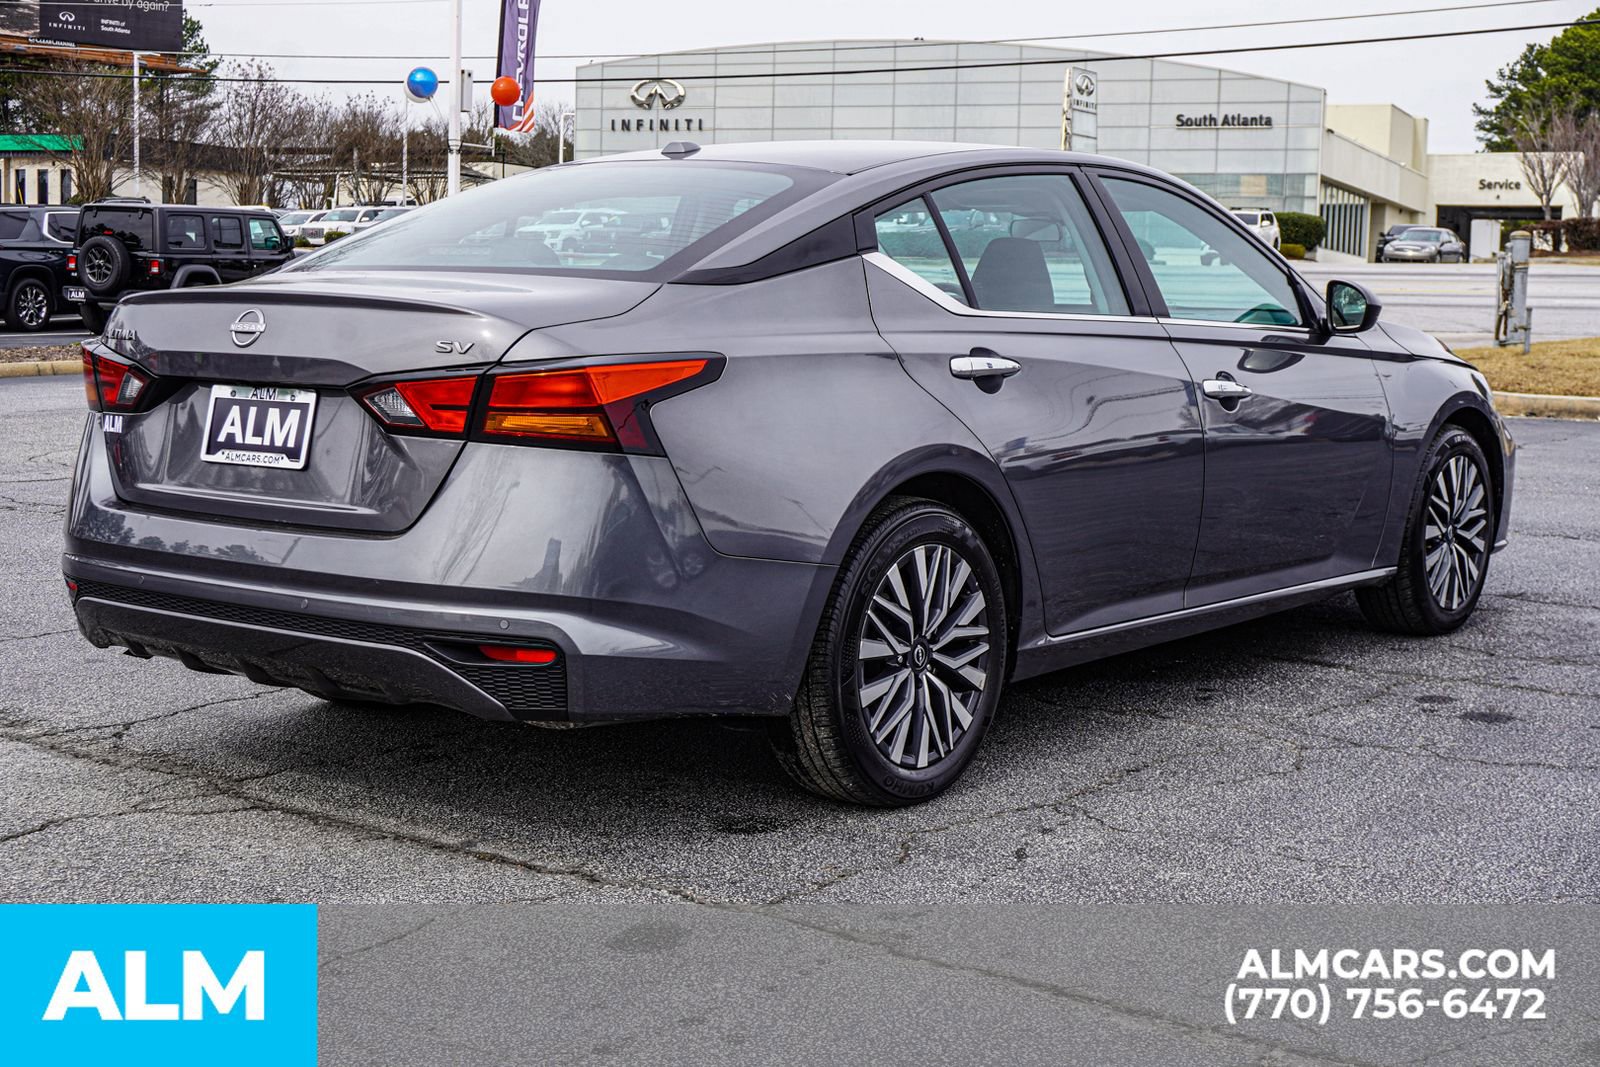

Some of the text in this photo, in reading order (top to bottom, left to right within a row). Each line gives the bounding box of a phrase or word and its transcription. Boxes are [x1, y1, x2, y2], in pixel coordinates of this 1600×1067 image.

[136, 0, 170, 12] again?
[48, 22, 86, 31] INFINITI
[611, 118, 703, 132] INFINITI
[1175, 113, 1273, 127] South Atlanta
[1478, 178, 1521, 190] Service
[70, 291, 85, 299] ALM
[230, 323, 266, 331] NISSAN
[435, 341, 475, 354] SV
[250, 387, 277, 400] ALM
[104, 415, 122, 433] ALM
[216, 405, 301, 448] ALM
[225, 451, 280, 464] ALMCARS.COM
